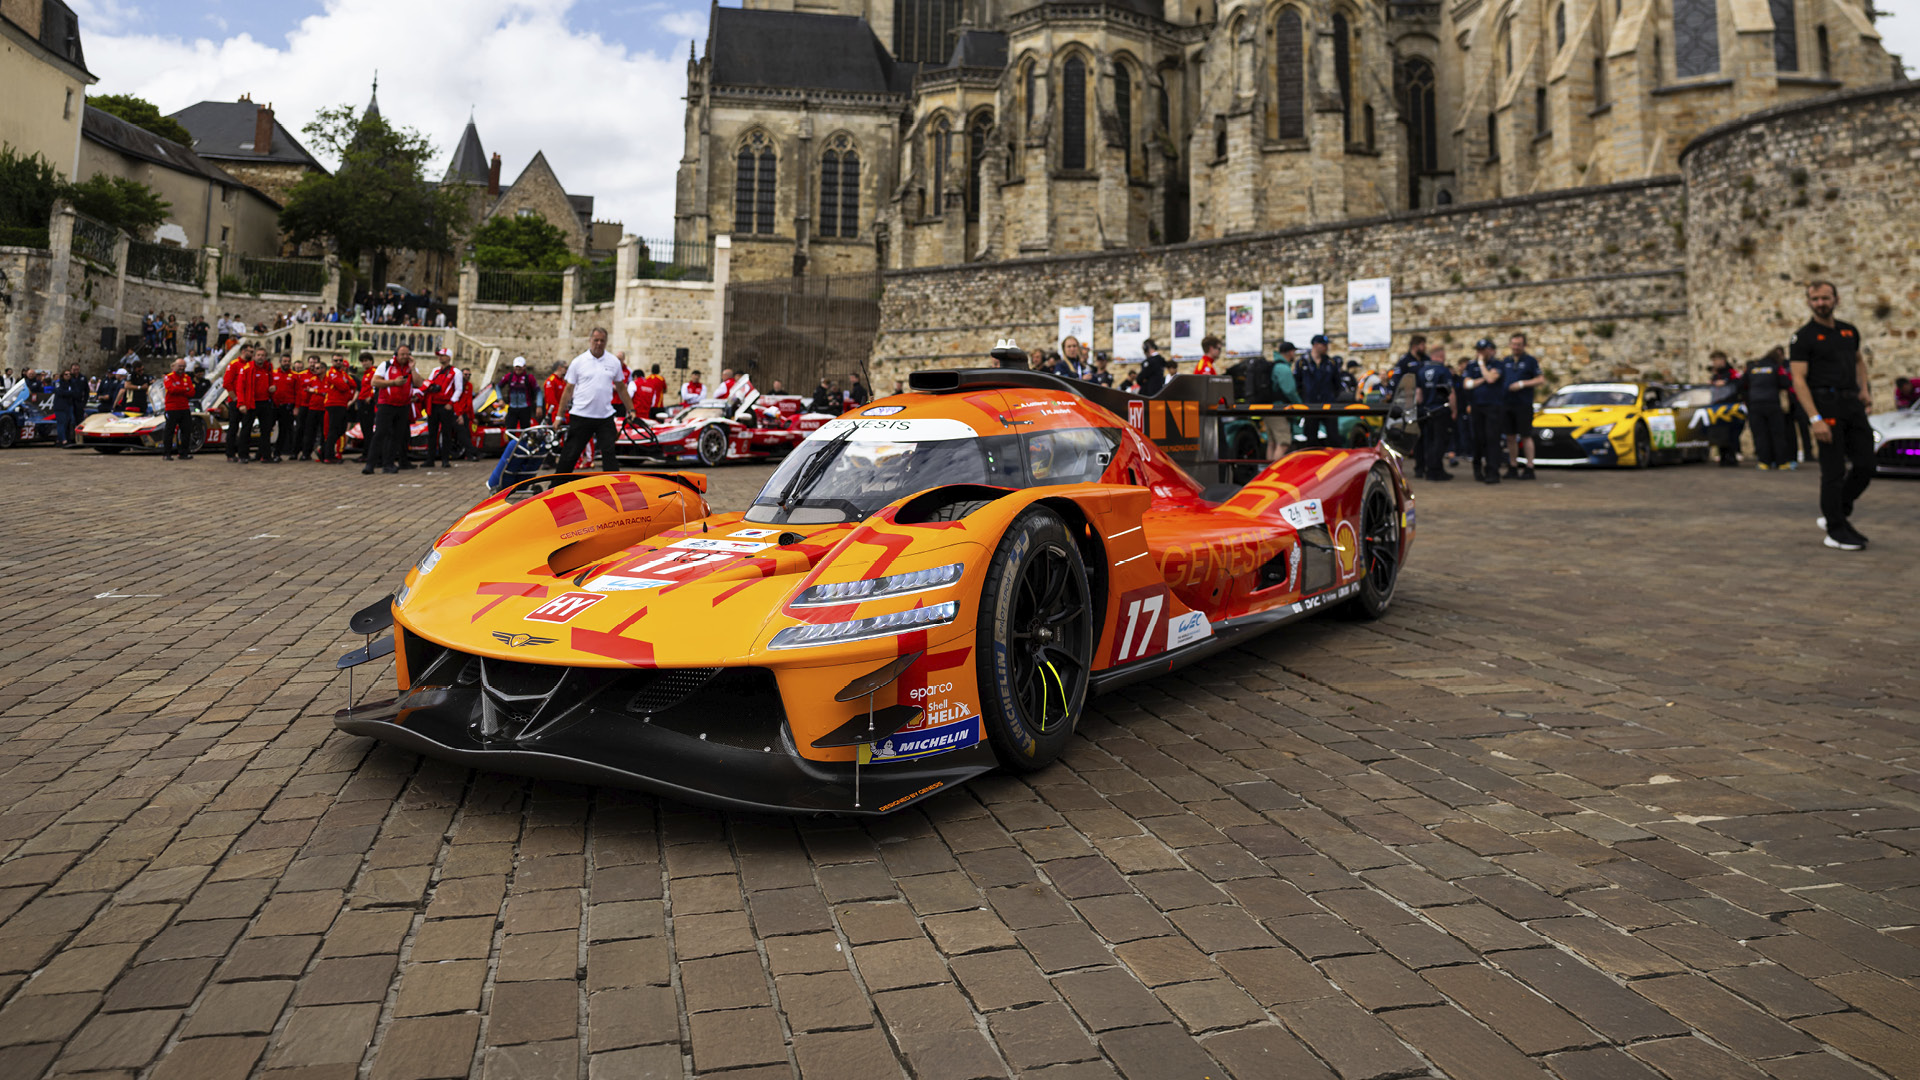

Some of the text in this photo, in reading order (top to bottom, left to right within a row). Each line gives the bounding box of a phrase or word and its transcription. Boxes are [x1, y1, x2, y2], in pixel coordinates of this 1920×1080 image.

[824, 420, 911, 431] GENESIS
[1129, 407, 1143, 429] HY
[21, 427, 35, 439] 35
[207, 429, 220, 442] 12
[1653, 431, 1674, 447] 78
[560, 515, 652, 540] GENESIS MAGMA RACING
[1160, 528, 1276, 588] GENESIS
[1003, 570, 1014, 604] SPORT
[536, 596, 597, 617] HY
[1118, 594, 1164, 661] 17
[1178, 612, 1203, 633] WEC
[910, 682, 953, 701] sparco
[998, 651, 1025, 740] MICHELIN
[927, 702, 971, 725] HELIX
[928, 699, 948, 712] Shell
[899, 729, 969, 752] MICHELIN
[879, 795, 911, 812] DESIGNED
[918, 780, 944, 795] GENESIS
